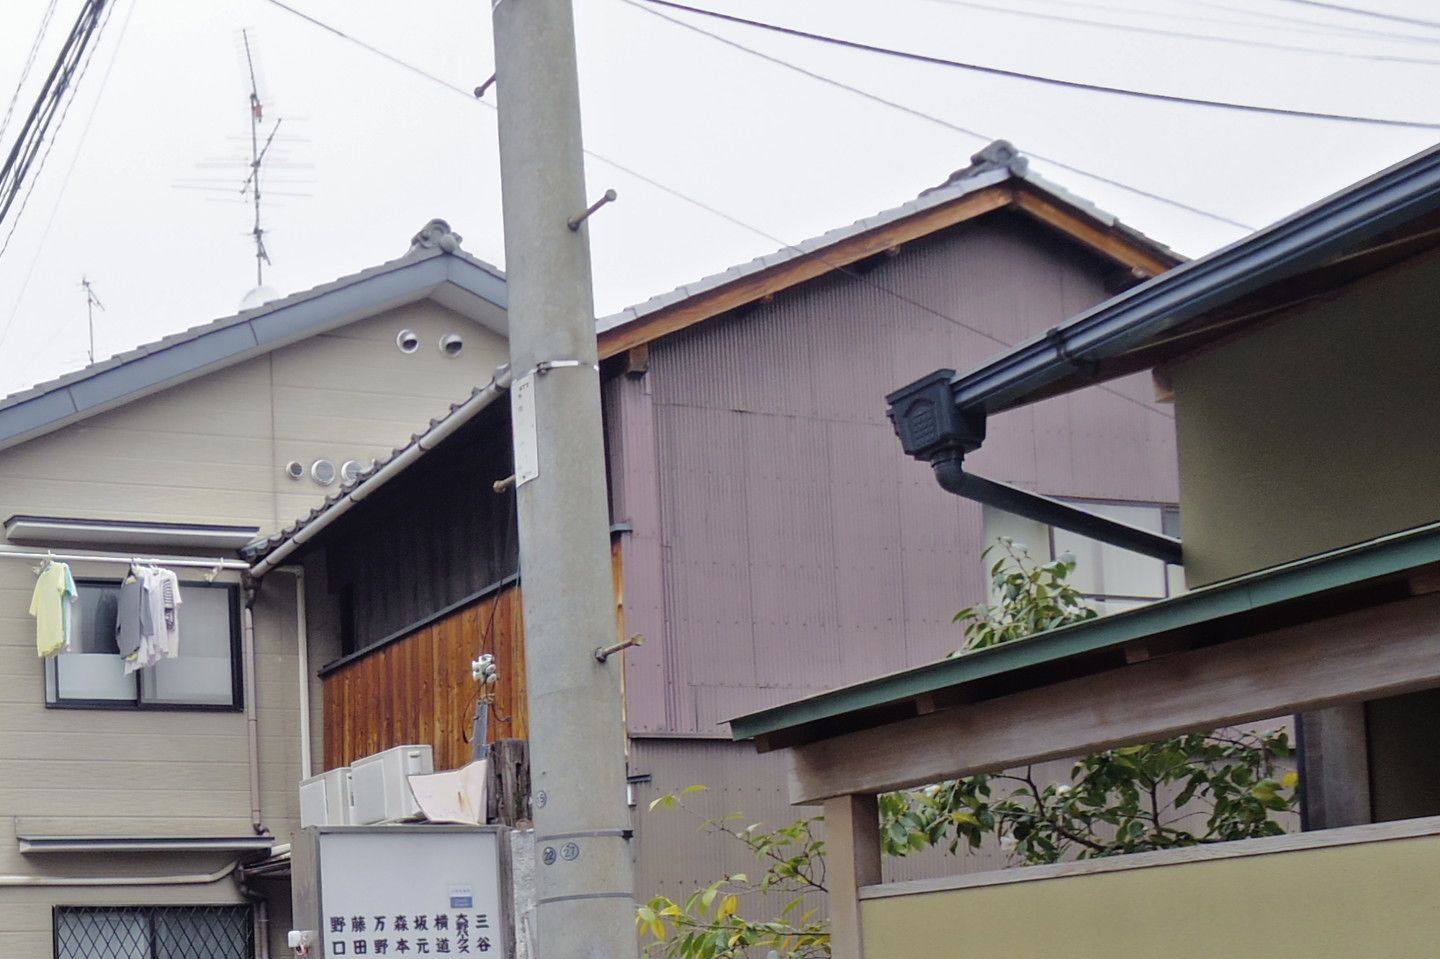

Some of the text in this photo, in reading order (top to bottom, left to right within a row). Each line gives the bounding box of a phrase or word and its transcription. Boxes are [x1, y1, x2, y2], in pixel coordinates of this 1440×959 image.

[330, 916, 346, 955] 野口
[351, 916, 367, 955] 藤田
[374, 915, 388, 954] 万野
[394, 915, 410, 954] 森本
[413, 915, 430, 954] 坂元
[433, 914, 451, 953] 横道
[475, 914, 491, 952] 三谷
